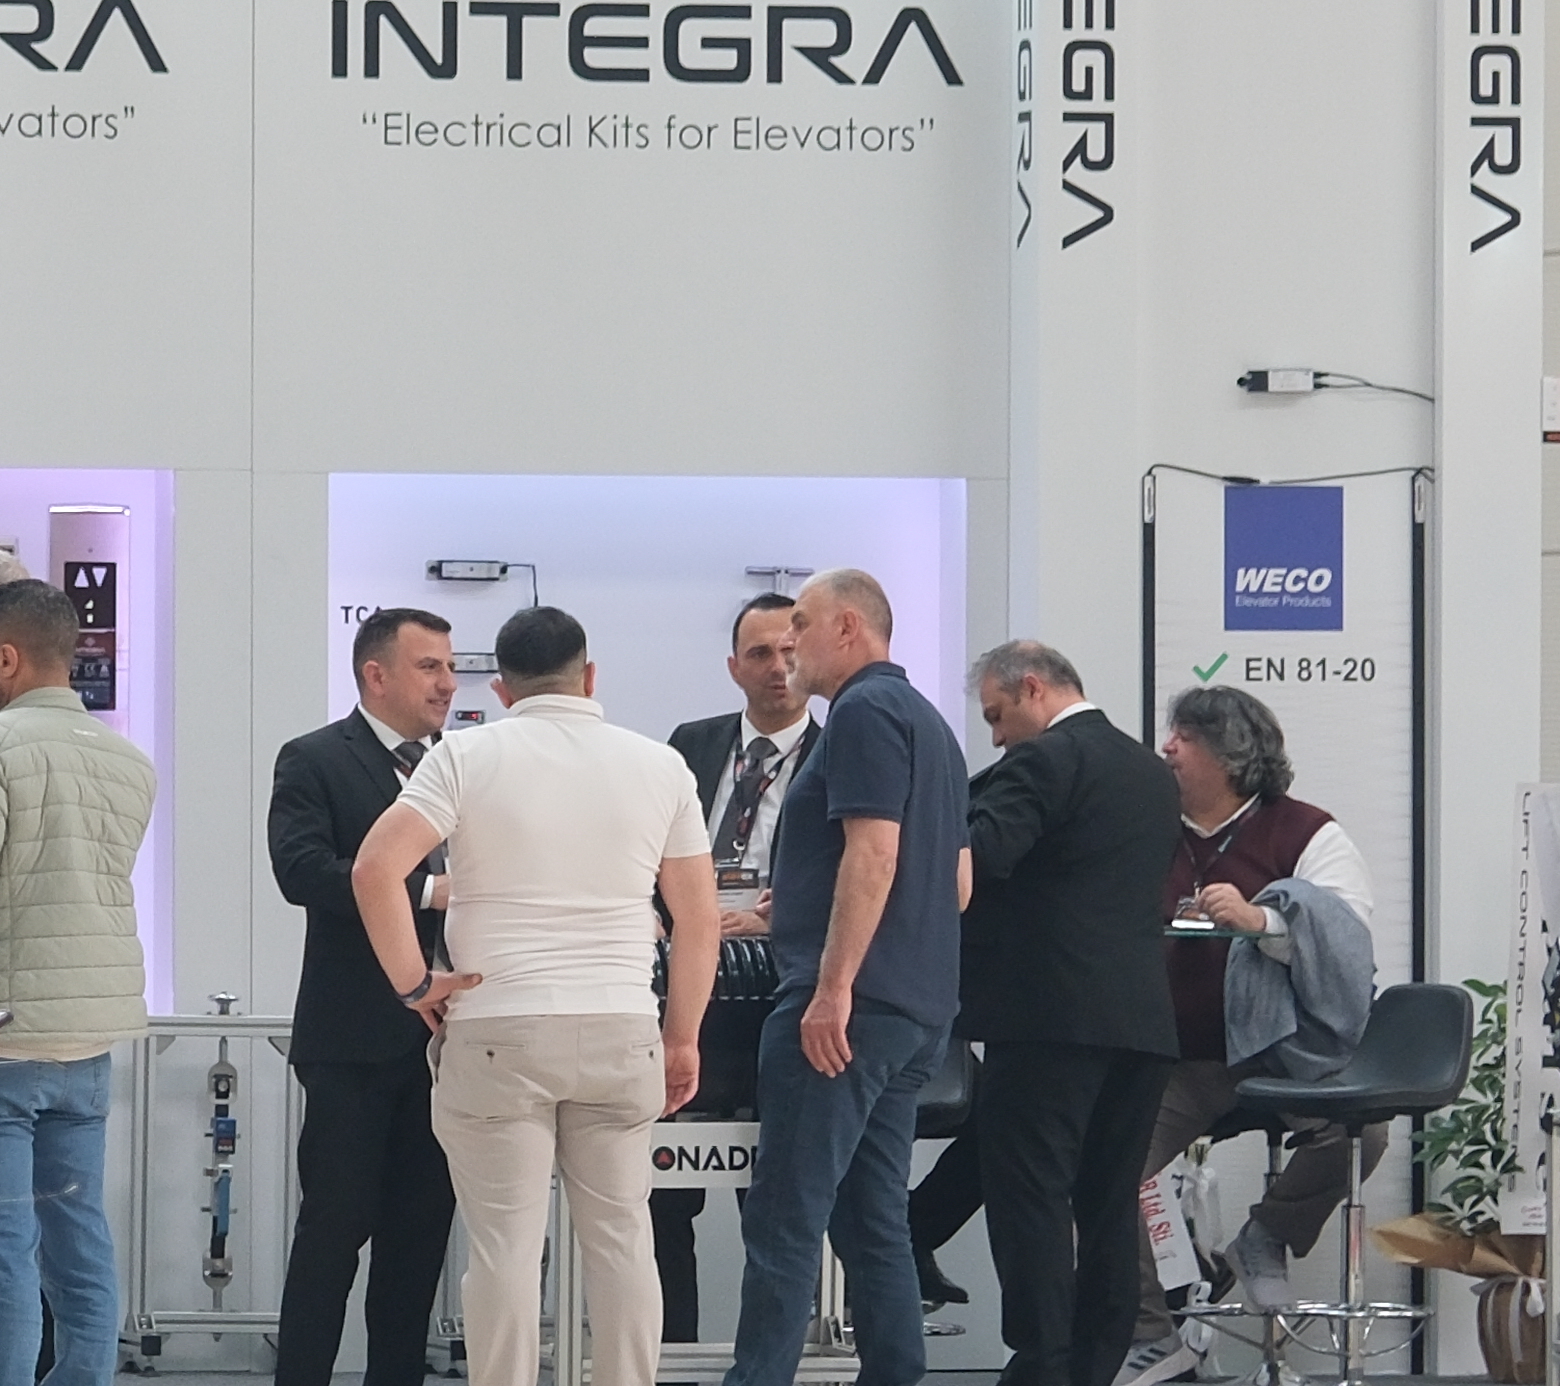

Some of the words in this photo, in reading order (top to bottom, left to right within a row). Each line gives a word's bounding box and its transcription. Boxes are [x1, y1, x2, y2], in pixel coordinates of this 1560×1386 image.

[332, 0, 964, 86] INTEGRA
[589, 114, 649, 149] Kits
[667, 115, 718, 149] for
[1236, 568, 1332, 592] WECO
[340, 605, 383, 625] TC
[1246, 658, 1284, 681] EN
[1298, 658, 1375, 681] 81-20
[1513, 869, 1529, 1027] CONTROL
